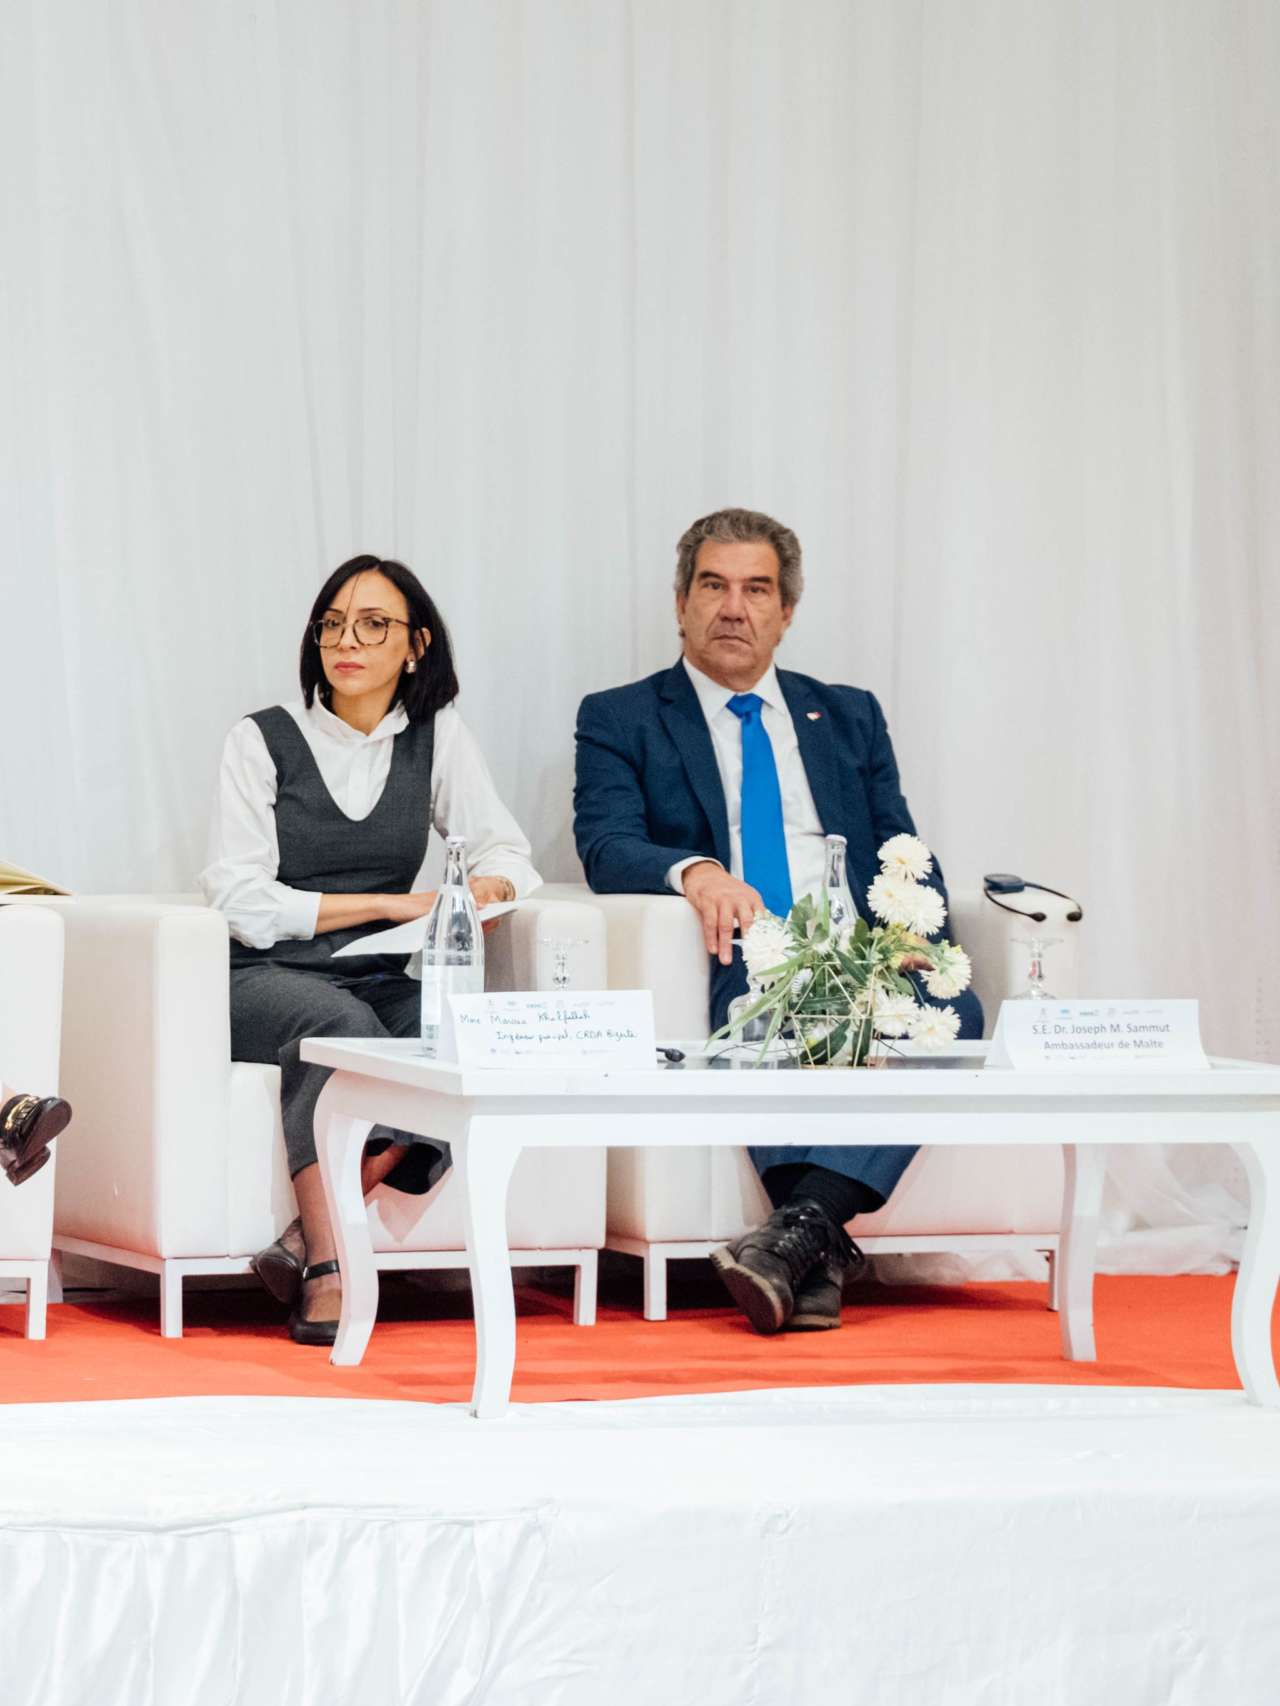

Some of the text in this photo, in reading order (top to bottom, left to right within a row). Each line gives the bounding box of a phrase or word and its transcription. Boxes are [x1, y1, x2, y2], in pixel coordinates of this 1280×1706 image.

[1032, 1023, 1170, 1035] S.E. Dr. Joseph M. Sammut
[1044, 1039, 1164, 1050] Ambassadeur de Malte
